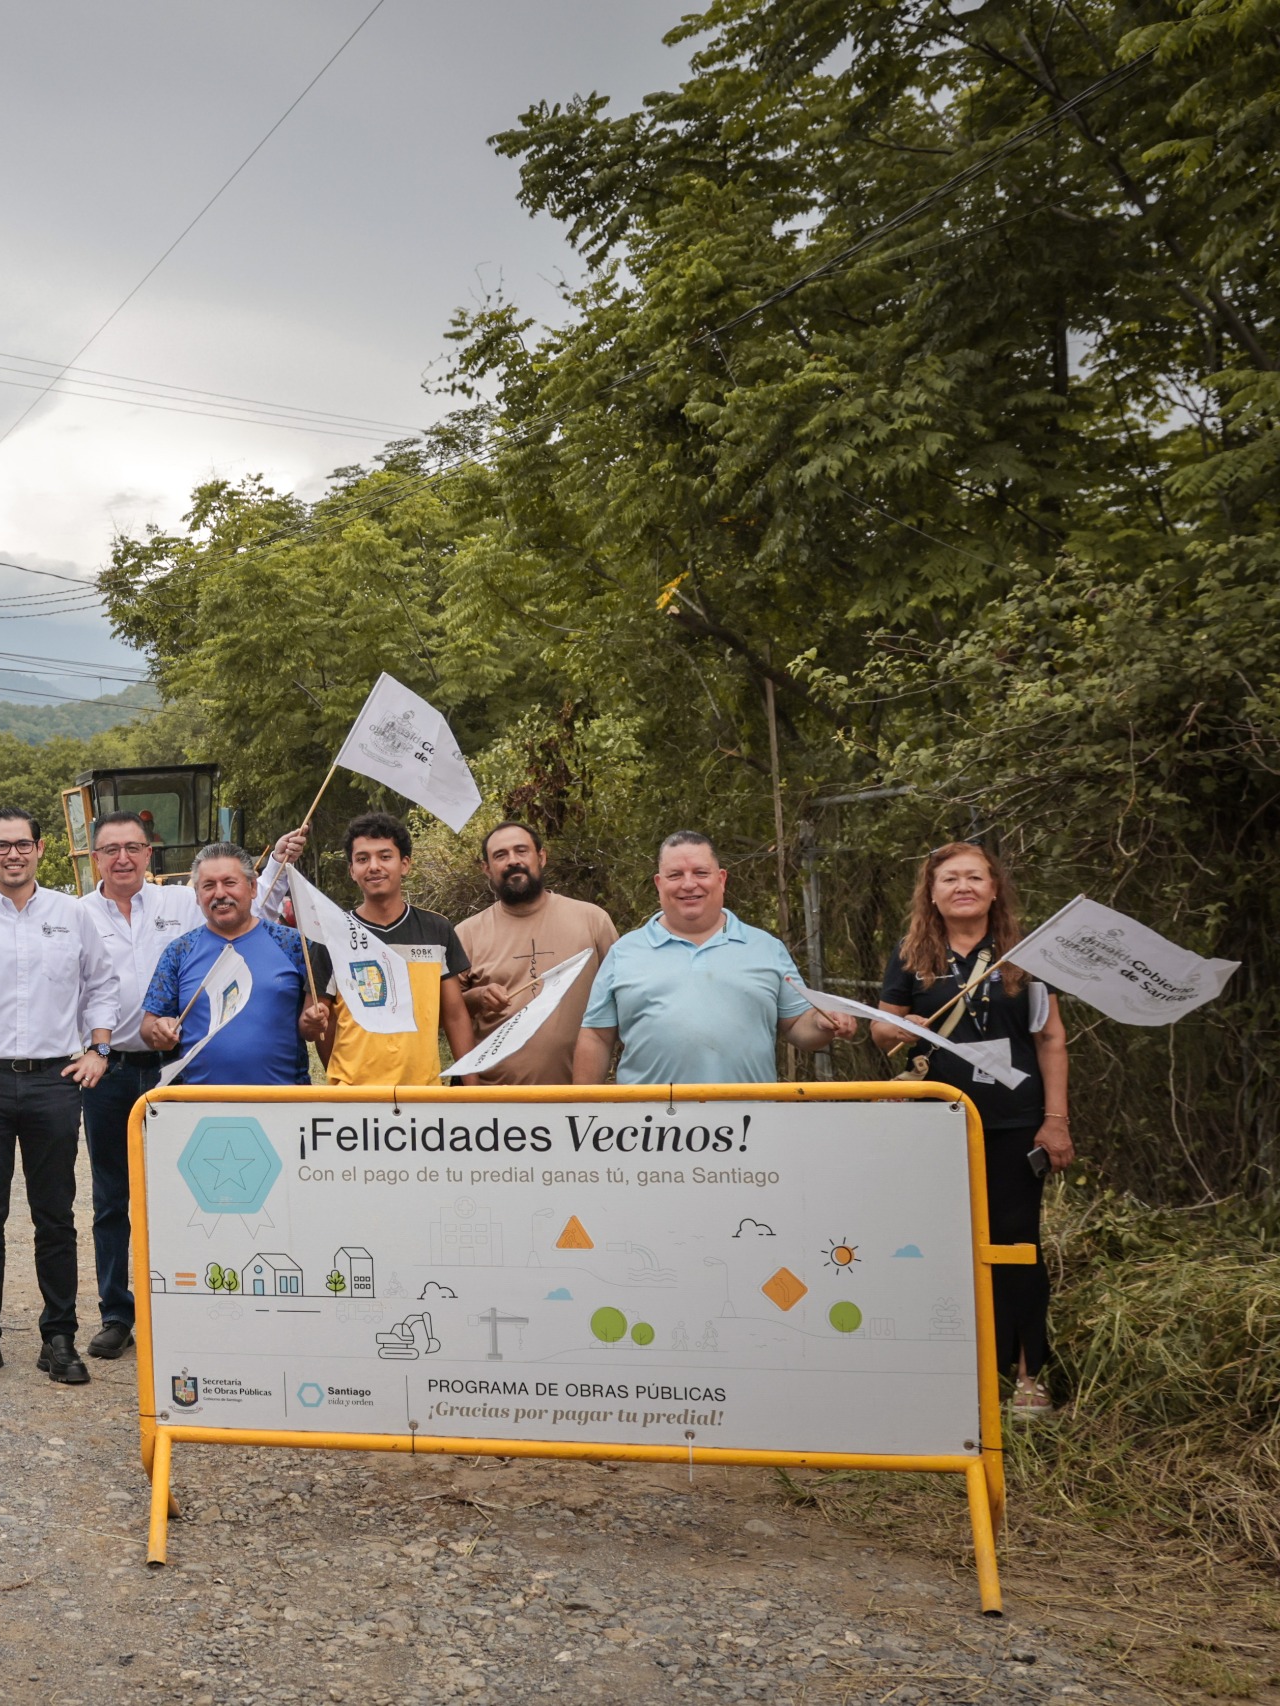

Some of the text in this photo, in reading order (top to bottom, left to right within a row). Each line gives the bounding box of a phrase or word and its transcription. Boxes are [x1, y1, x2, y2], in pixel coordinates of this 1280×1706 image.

[360, 932, 369, 950] de
[1120, 968, 1139, 982] de
[300, 1115, 751, 1159] ¡Felicidades Vecinos!
[298, 1166, 779, 1187] Con el pago de tu predial ganas tú, gana Santiago
[240, 1388, 271, 1396] Públicas
[328, 1387, 371, 1397] Santiago
[429, 1380, 726, 1401] PROGRAMA DE OBRAS PÚBLICAS
[429, 1402, 723, 1427] ¡Gracias por pagar tu predial!
